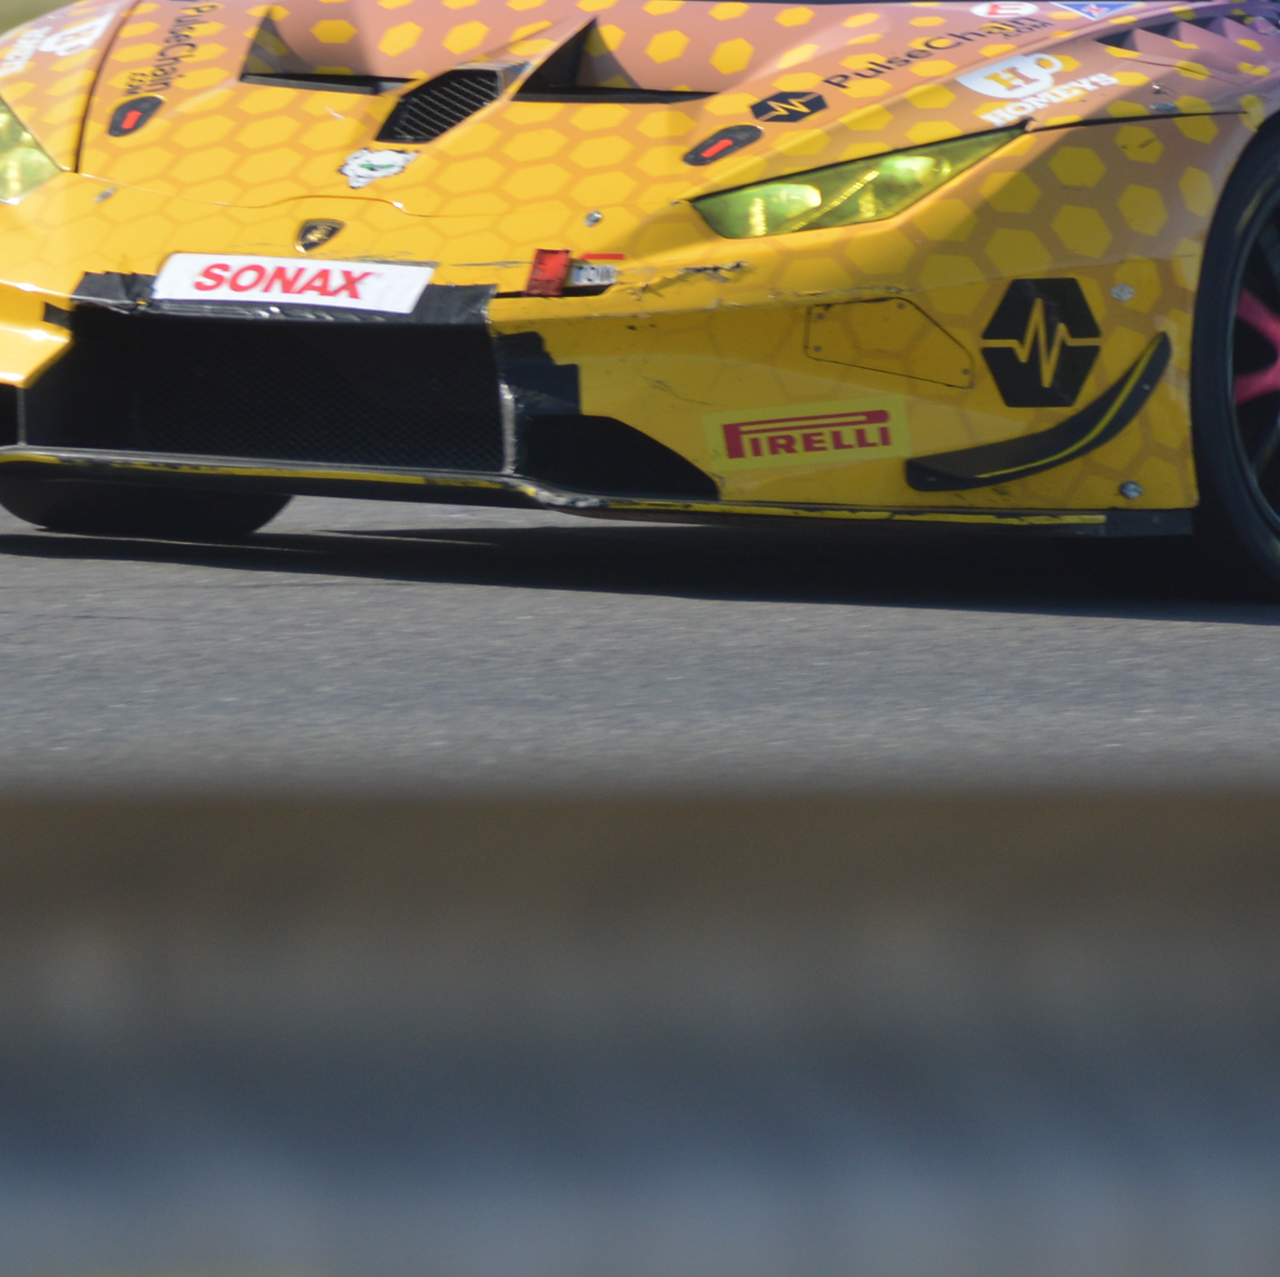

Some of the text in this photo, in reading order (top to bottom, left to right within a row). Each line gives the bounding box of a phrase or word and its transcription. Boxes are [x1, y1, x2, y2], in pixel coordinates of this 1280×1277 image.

[822, 16, 1037, 90] PulseChain
[193, 263, 375, 300] SONAX
[722, 409, 892, 460] PIRELLI
